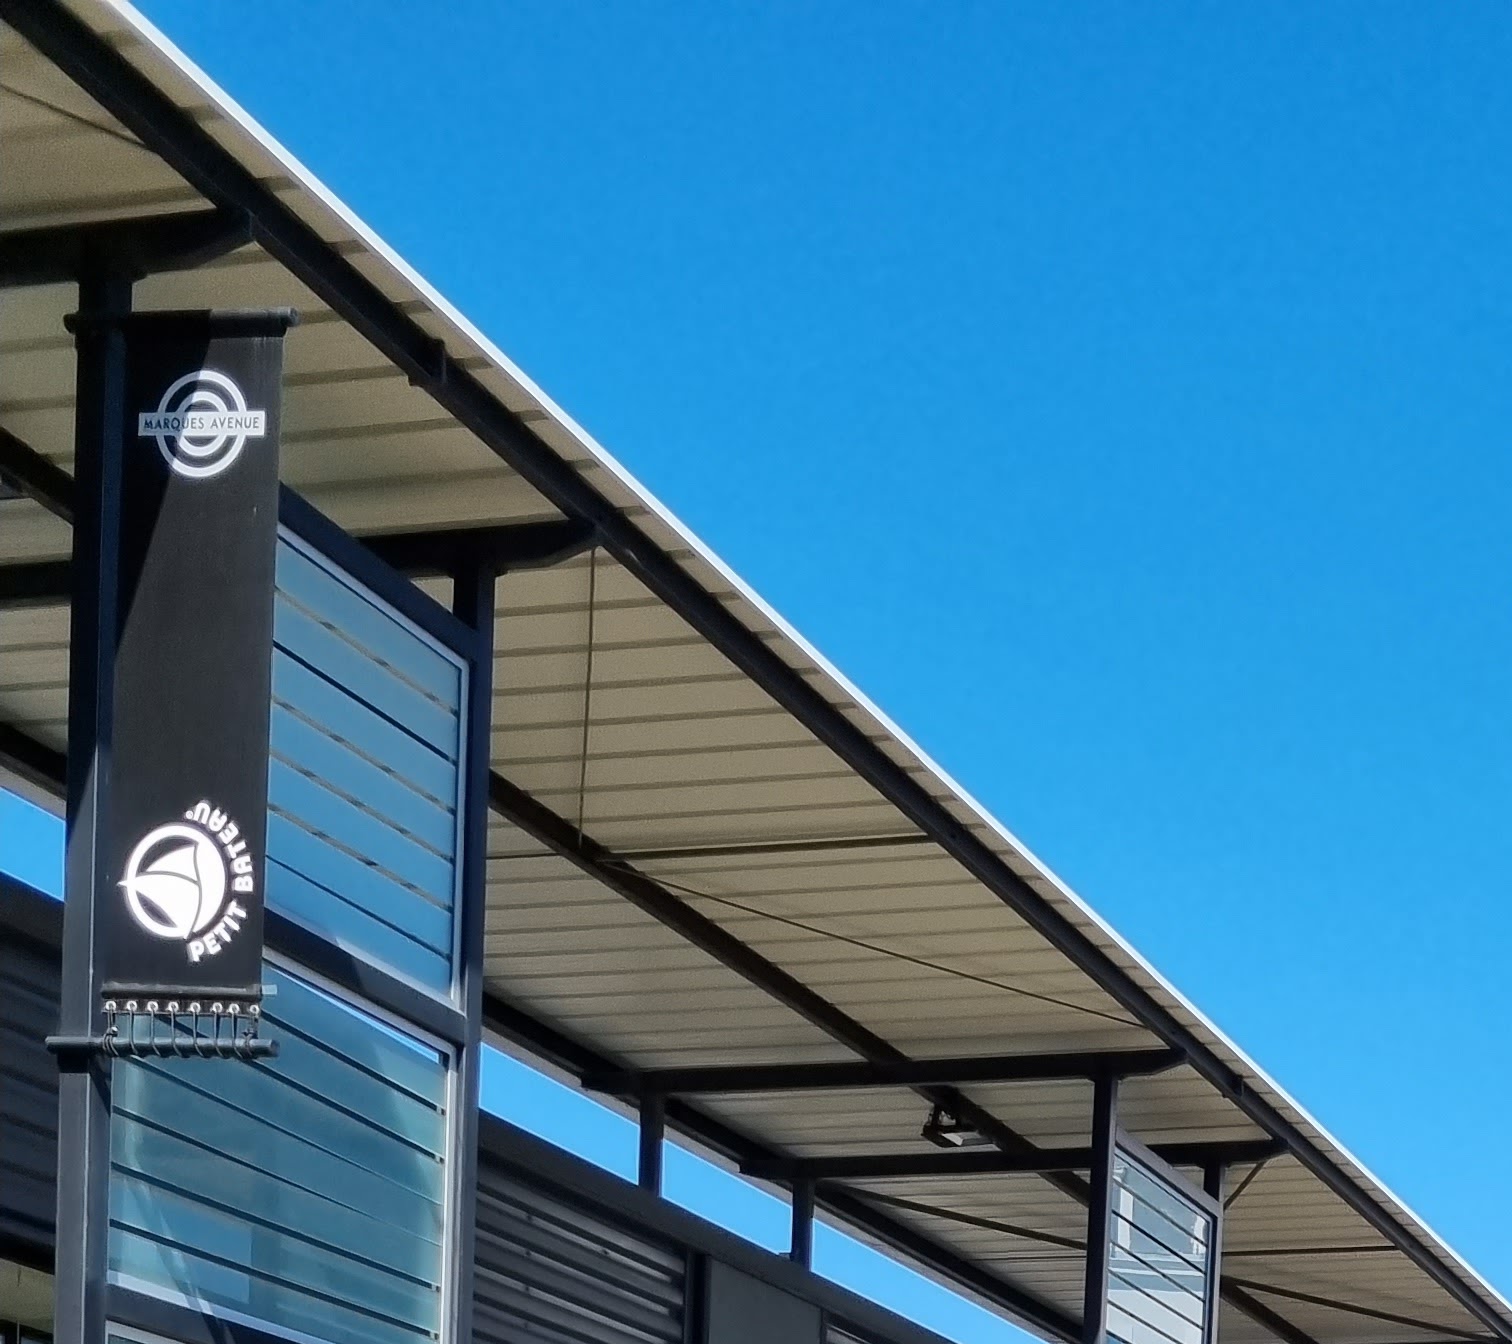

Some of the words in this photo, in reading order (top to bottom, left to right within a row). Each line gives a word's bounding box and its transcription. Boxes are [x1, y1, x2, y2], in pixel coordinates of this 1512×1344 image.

[143, 416, 205, 432] MARQUES
[210, 416, 260, 430] AVENUE
[191, 802, 254, 892] BATEAU
[187, 899, 247, 962] PETIT
